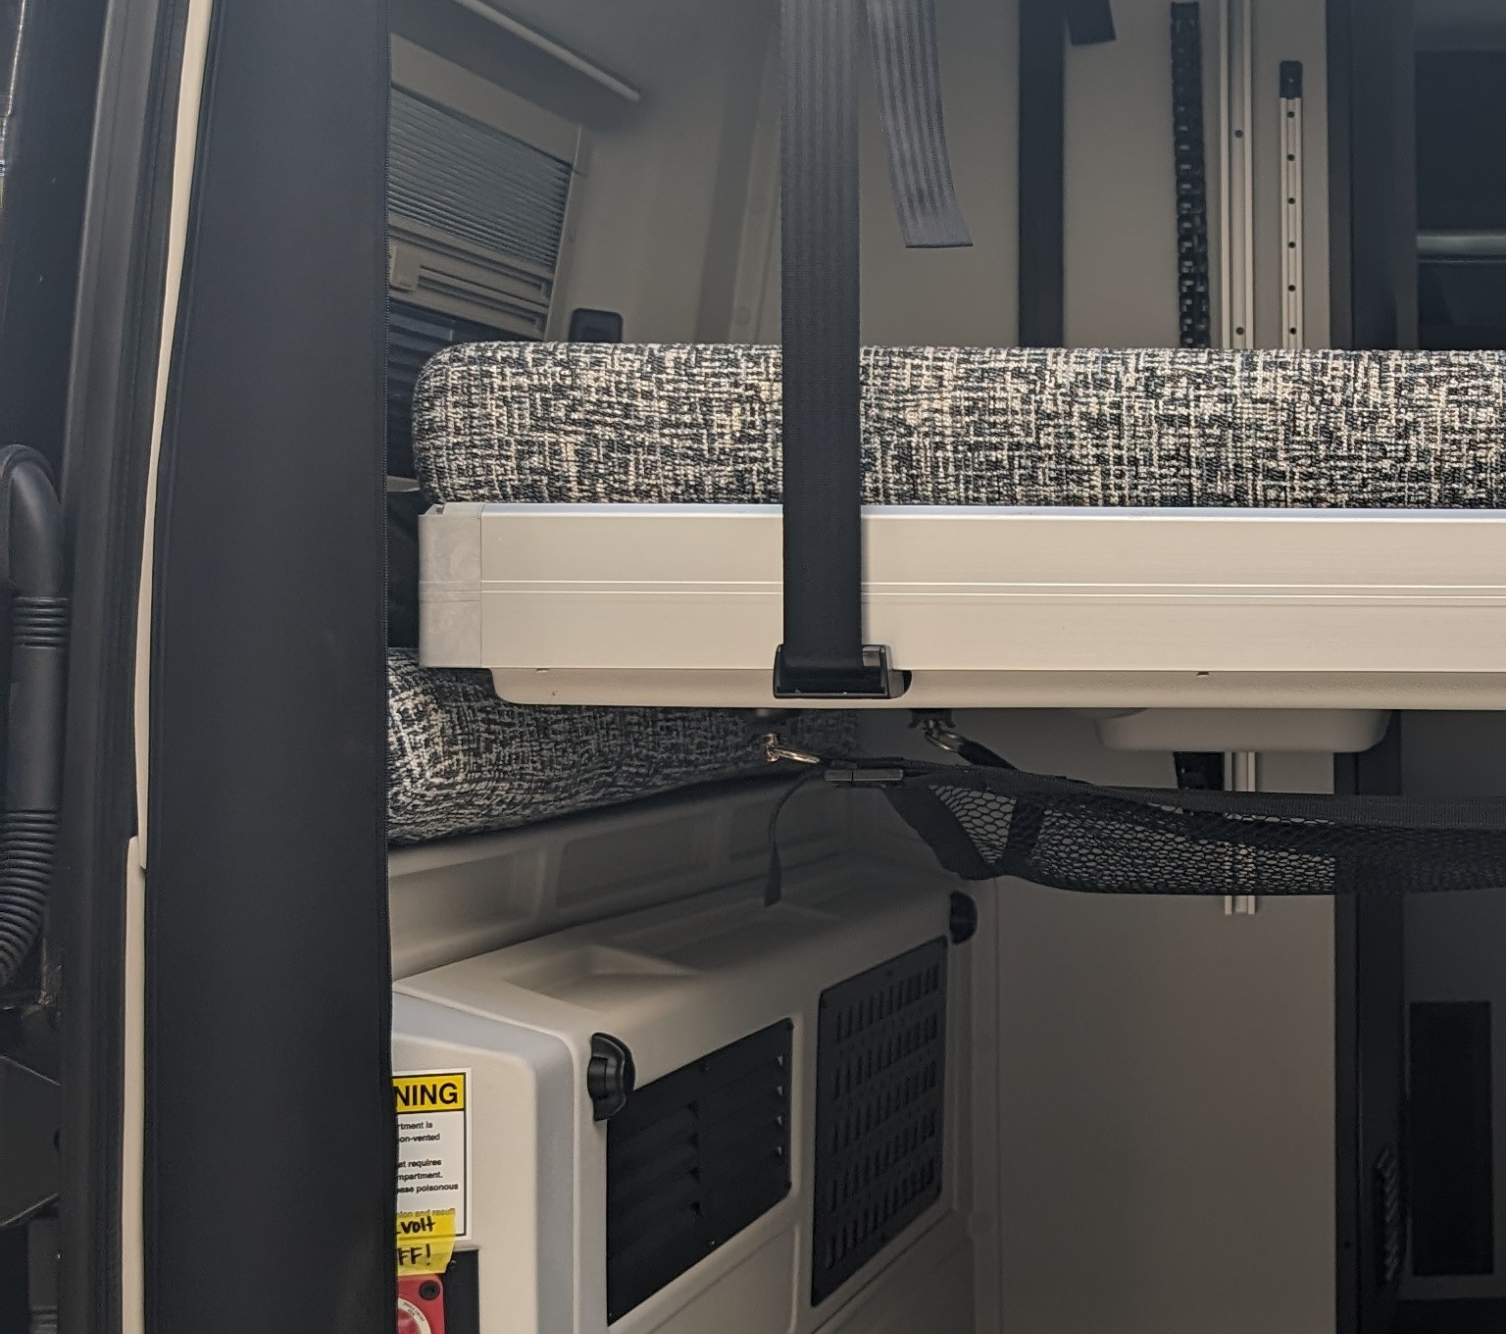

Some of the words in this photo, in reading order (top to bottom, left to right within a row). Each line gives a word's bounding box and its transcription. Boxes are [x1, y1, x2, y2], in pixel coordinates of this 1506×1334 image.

[393, 1082, 458, 1107] NING
[425, 1120, 433, 1129] is
[398, 1132, 441, 1143] on-vented
[408, 1158, 442, 1169] requires
[397, 1171, 443, 1182] mpartment.
[415, 1183, 459, 1195] poisonous
[397, 1243, 432, 1266] FF!
